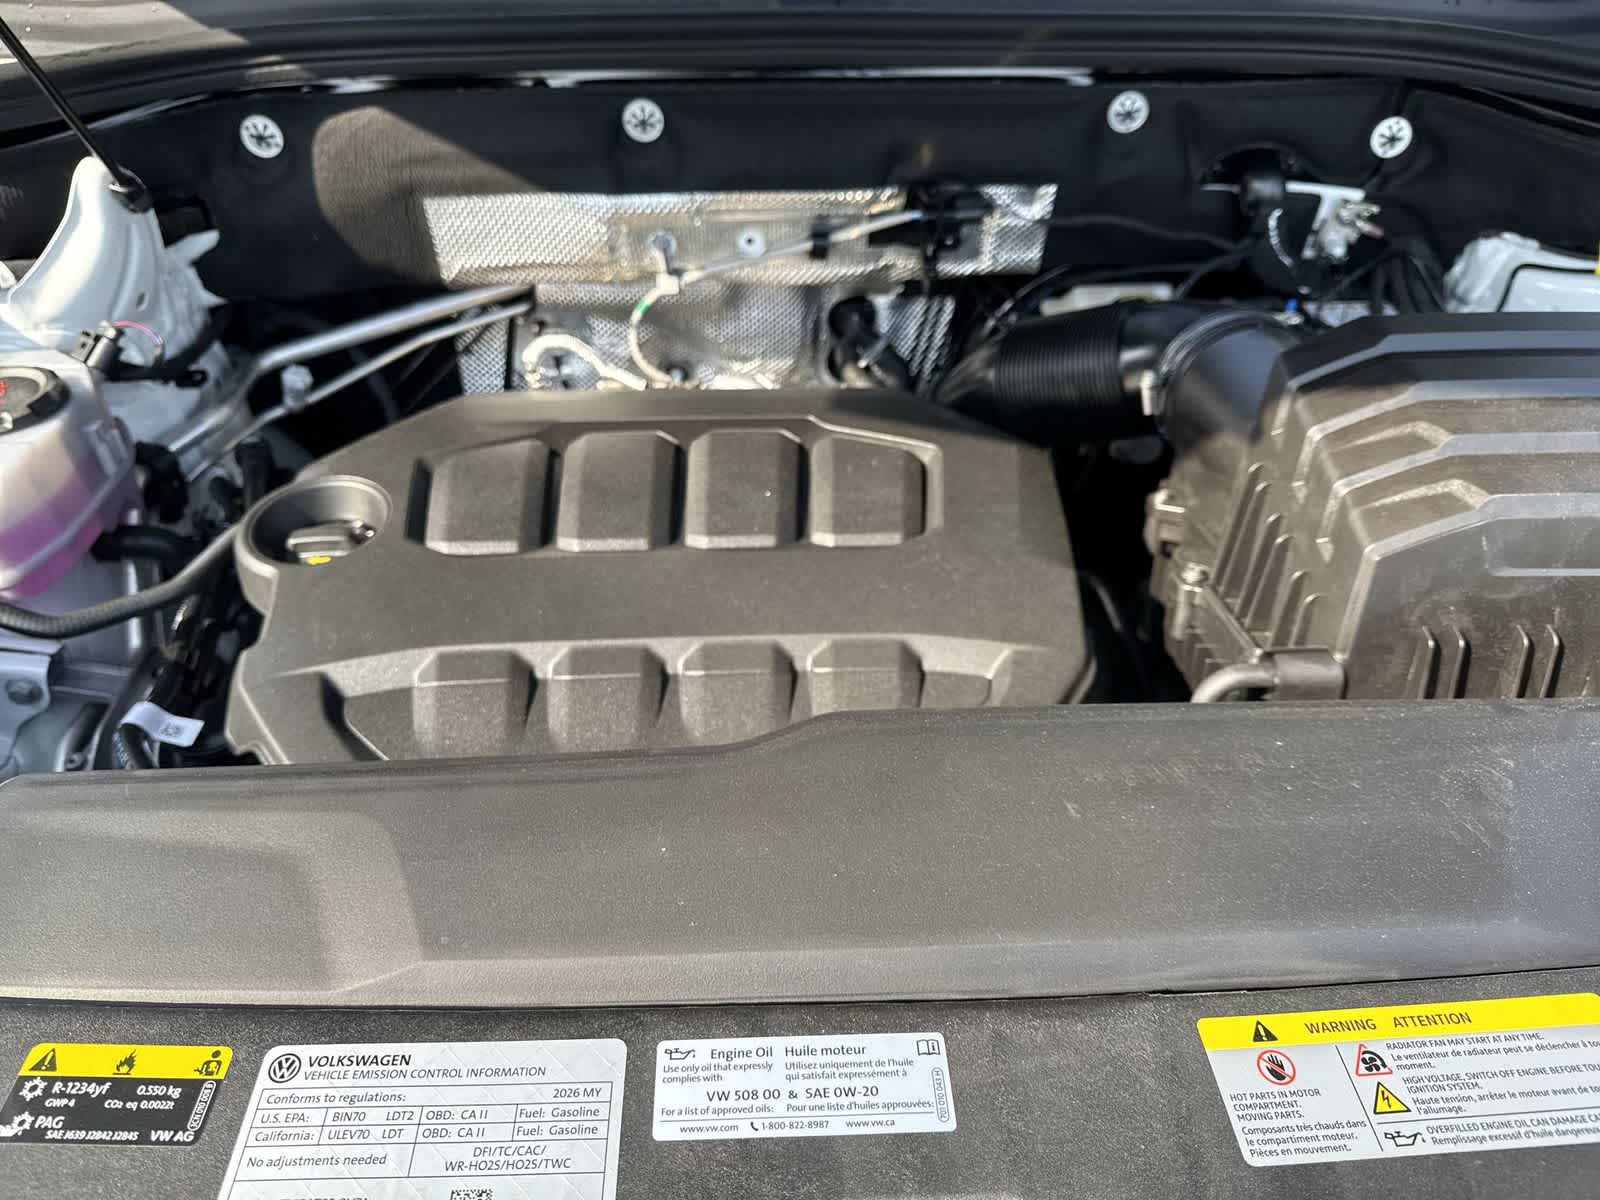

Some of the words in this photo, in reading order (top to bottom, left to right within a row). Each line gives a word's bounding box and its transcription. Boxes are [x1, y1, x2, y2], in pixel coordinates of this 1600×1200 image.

[1304, 1018, 1377, 1034] WARNING
[1393, 1012, 1472, 1028] ATTENTION
[1386, 1040, 1428, 1050] RADIATOR
[1428, 1039, 1447, 1048] FAN
[1447, 1037, 1465, 1046] MAY
[1465, 1035, 1492, 1045] START
[1491, 1035, 1502, 1043] AT
[1503, 1033, 1520, 1042] ANY
[711, 1048, 752, 1061] Engine
[756, 1046, 773, 1058] Oil
[785, 1045, 817, 1057] Huile
[821, 1045, 866, 1056] moteur
[1391, 1053, 1402, 1062] Le
[1404, 1049, 1449, 1061] ventilateur
[1450, 1049, 1462, 1057] de
[1463, 1047, 1501, 1057] radiateur
[1503, 1045, 1521, 1055] peut
[308, 1054, 412, 1067] VOLKSWAGEN
[785, 1061, 818, 1070] Utilisez
[819, 1060, 873, 1071] uniquement
[875, 1058, 886, 1067] de
[888, 1057, 914, 1067] l'huile
[1396, 1060, 1436, 1071] moment.
[304, 1070, 349, 1080] VEHICLE
[352, 1069, 407, 1080] EMISSION
[410, 1068, 463, 1079] CONTROL
[466, 1067, 546, 1078] INFORMATION
[663, 1065, 679, 1073] Use
[681, 1064, 699, 1074] only
[701, 1063, 712, 1072] oil
[713, 1063, 731, 1072] that
[733, 1061, 773, 1072] expressly
[662, 1074, 701, 1085] complies
[703, 1073, 723, 1082] with
[785, 1071, 800, 1083] qui
[801, 1070, 836, 1080] satisfait
[838, 1069, 899, 1080] expressément
[901, 1068, 908, 1078] à
[1402, 1074, 1425, 1085] HIGH
[1425, 1073, 1465, 1083] VOLTAGE,
[1465, 1070, 1498, 1081] SWITCH
[1499, 1068, 1516, 1078] OFF
[1517, 1066, 1549, 1077] ENGINE
[1548, 1064, 1584, 1075] BEFORE
[52, 1082, 111, 1098] R-1234yf
[137, 1085, 167, 1096] 0.550
[167, 1085, 182, 1099] kg
[553, 1088, 580, 1098] 2026
[582, 1087, 602, 1097] MY
[707, 1089, 731, 1101] VW
[735, 1089, 759, 1101] 508
[763, 1088, 781, 1100] 00
[787, 1089, 799, 1099] &
[805, 1087, 830, 1099] SAE
[834, 1086, 879, 1097] 0W-20
[1407, 1082, 1446, 1094] IGNITION
[1446, 1081, 1483, 1091] SYSTEM.
[266, 1094, 321, 1105] Conforms
[324, 1093, 336, 1103] to
[338, 1092, 407, 1105] regulations:
[1230, 1092, 1247, 1102] HOT
[1249, 1090, 1277, 1101] PARTS
[1277, 1089, 1288, 1099] IN
[1289, 1087, 1321, 1098] MOTOR
[1412, 1095, 1440, 1106] Haute
[1440, 1093, 1477, 1104] tension,
[1507, 1090, 1517, 1099] le
[1518, 1088, 1550, 1098] moteur
[1551, 1086, 1576, 1096] avant
[1576, 1085, 1589, 1094] de
[45, 1098, 68, 1107] GWP
[68, 1098, 76, 1107] 4
[125, 1101, 138, 1111] eq
[140, 1100, 175, 1110] 0.0022t
[787, 1103, 807, 1112] Pour
[808, 1104, 825, 1112] une
[827, 1102, 845, 1111] liste
[846, 1101, 879, 1111] d'huiles
[881, 1099, 935, 1111] approuvées:
[1233, 1099, 1302, 1112] COMPARTMENT.
[332, 1111, 366, 1122] BIN70
[386, 1111, 415, 1121] LDT2
[426, 1110, 455, 1120] OBD:
[461, 1109, 477, 1120] CA
[519, 1108, 546, 1118] Fuel:
[551, 1106, 600, 1118] Gasoline
[661, 1107, 675, 1116] For
[677, 1108, 683, 1116] a
[684, 1106, 698, 1115] list
[700, 1106, 711, 1115] of
[711, 1105, 754, 1117] approved
[755, 1103, 774, 1113] oils:
[1237, 1110, 1273, 1122] MOVING
[1274, 1109, 1304, 1120] PARTS.
[34, 1116, 65, 1129] PAG
[261, 1113, 281, 1124] U.S.
[284, 1113, 310, 1123] EPA:
[1426, 1123, 1480, 1135] OVERFILLED
[1481, 1120, 1514, 1131] ENGINE
[1514, 1119, 1531, 1129] OIL
[1530, 1117, 1550, 1128] CAN
[1549, 1115, 1588, 1126] DAMAGE
[422, 1128, 452, 1138] OBD:
[457, 1127, 473, 1138] CA
[516, 1125, 543, 1136] Fuel:
[549, 1124, 598, 1136] Gasoline
[680, 1125, 739, 1133] www.vw.com
[761, 1120, 829, 1130] 1-800-822-8987
[846, 1119, 895, 1128] www.vw.ca
[1241, 1123, 1295, 1137] Composants
[1314, 1120, 1345, 1131] chauds
[1346, 1119, 1367, 1129] dans
[45, 1130, 64, 1139] SAE
[151, 1130, 174, 1142] VW
[173, 1131, 195, 1142] AG
[255, 1130, 315, 1142] California:
[328, 1129, 370, 1140] ULEV70
[382, 1128, 404, 1139] LDT
[1245, 1138, 1255, 1147] le
[1256, 1134, 1321, 1148] compartiment
[1322, 1131, 1358, 1141] moteur.
[1432, 1132, 1487, 1146] Remplissage
[1488, 1130, 1523, 1142] excessif
[473, 1145, 546, 1157] DFI/TC/CAC/
[1250, 1147, 1279, 1158] Pièces
[1280, 1147, 1293, 1156] en
[1294, 1142, 1352, 1154] mouvement.
[247, 1157, 264, 1167] No
[266, 1155, 340, 1169] adjustments
[343, 1154, 387, 1165] needed
[445, 1158, 571, 1171] WR-HO2S/HO2S/TWC
